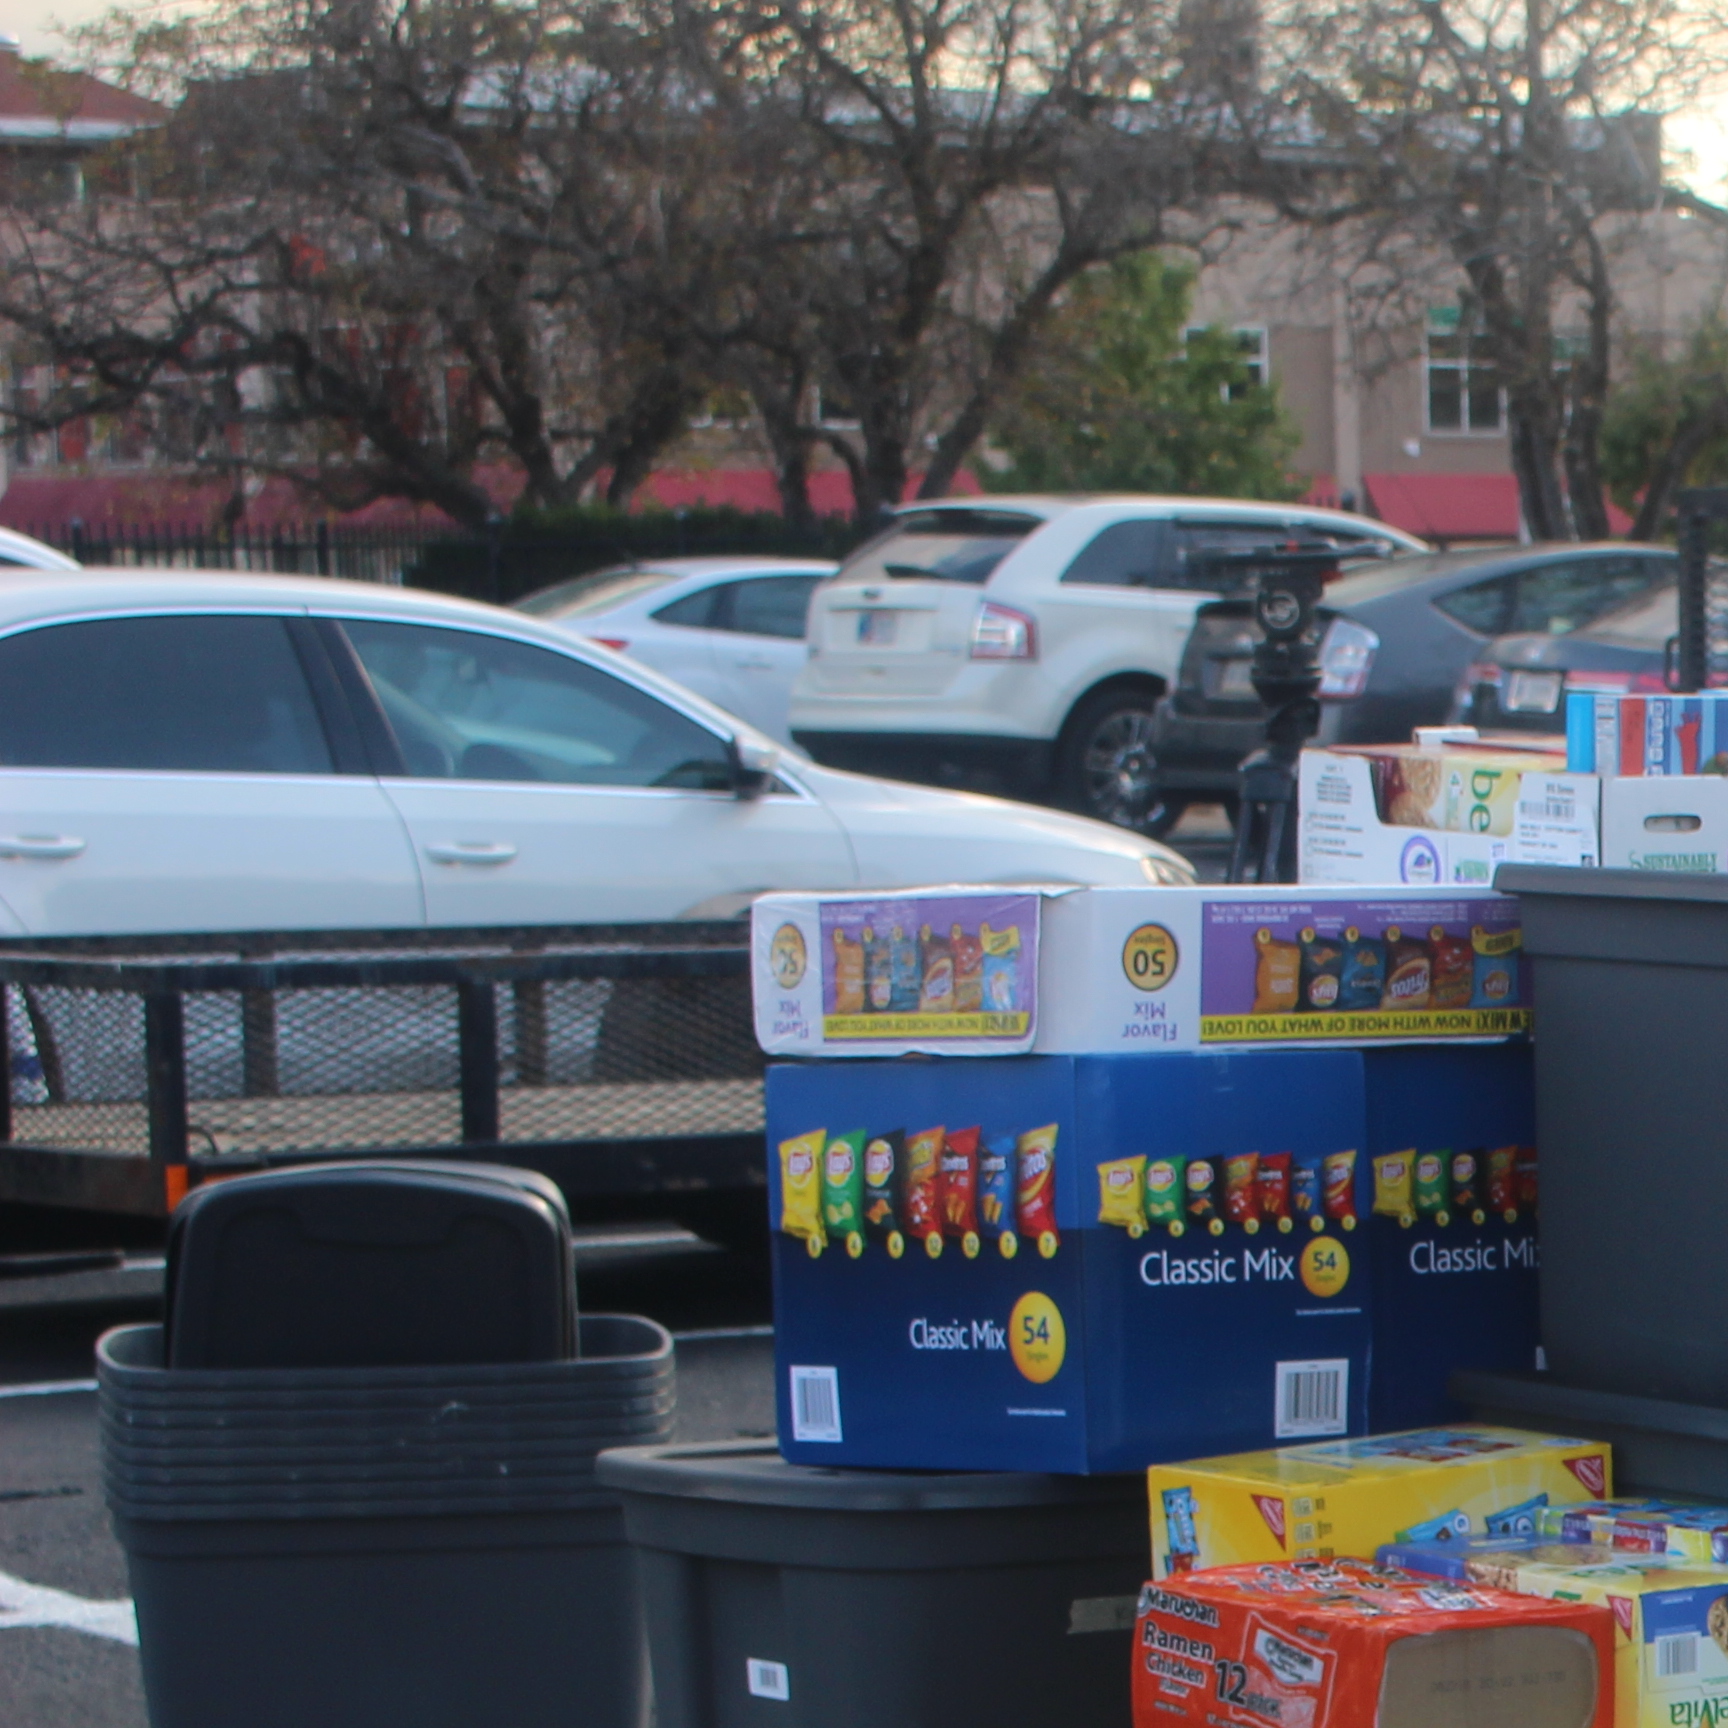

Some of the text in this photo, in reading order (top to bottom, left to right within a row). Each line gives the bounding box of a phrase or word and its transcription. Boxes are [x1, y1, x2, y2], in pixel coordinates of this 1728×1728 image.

[1132, 949, 1166, 977] 50
[1133, 1001, 1167, 1019] Mix
[1202, 1014, 1471, 1036] NOW WITH MORE OF WHAT YOU LOVE!
[1121, 1021, 1178, 1042] Flavor
[1140, 1247, 1295, 1286] Classic Mix
[1312, 1250, 1338, 1272] 54
[1408, 1238, 1541, 1275] Classic Mi
[909, 1318, 1007, 1350] Classic Mix
[1021, 1315, 1050, 1345] 54
[1142, 1620, 1215, 1664] Ramen
[1145, 1652, 1207, 1689] Chicken
[1215, 1659, 1248, 1705] 12
